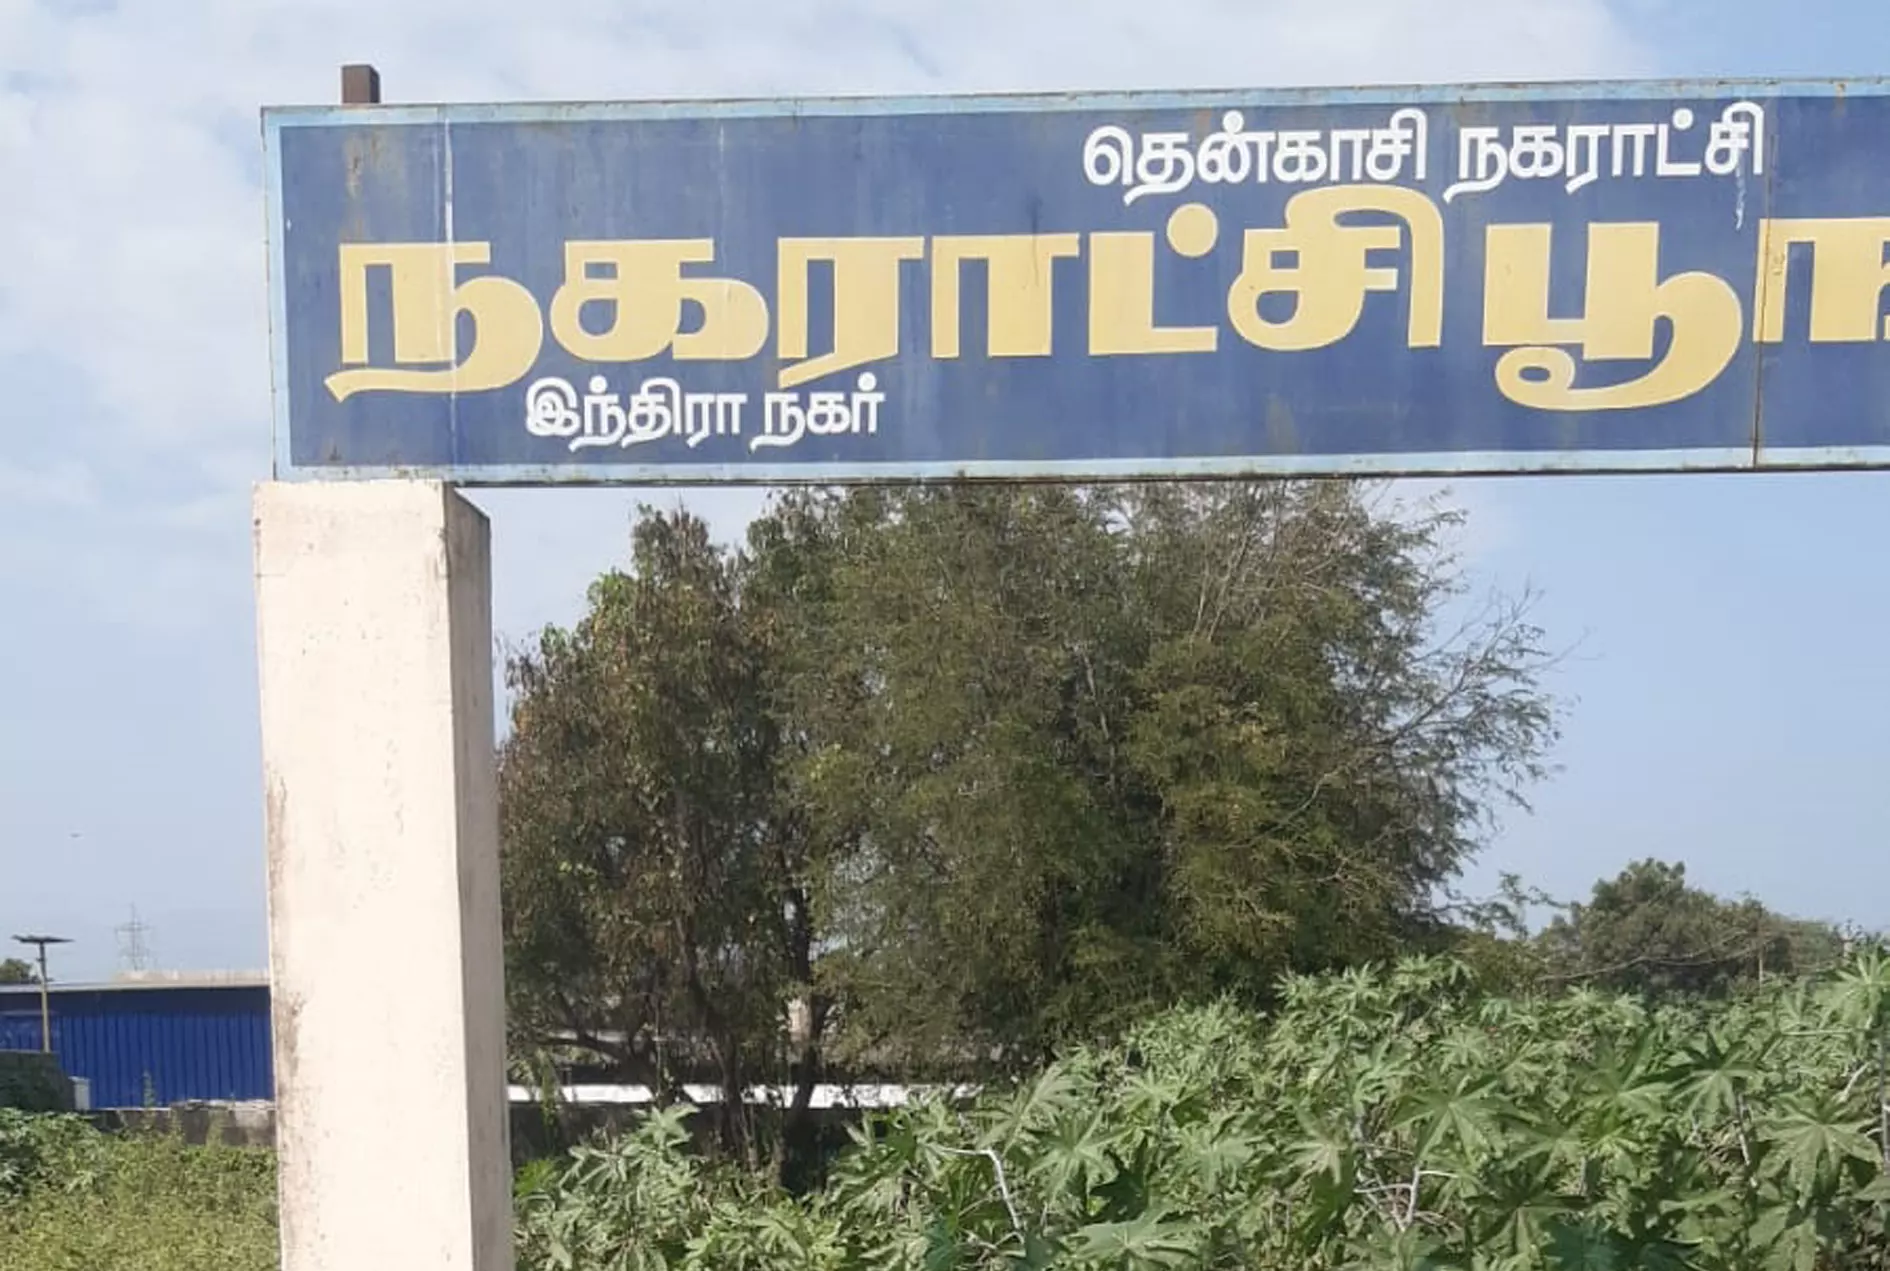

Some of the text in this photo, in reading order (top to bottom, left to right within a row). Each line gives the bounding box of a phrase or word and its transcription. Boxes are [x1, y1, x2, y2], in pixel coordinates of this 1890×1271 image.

[1083, 100, 1764, 204] தென்காசி நகராட்சி
[323, 184, 1444, 403] நகராட்சி
[525, 372, 886, 453] இந்திரா நகர்
